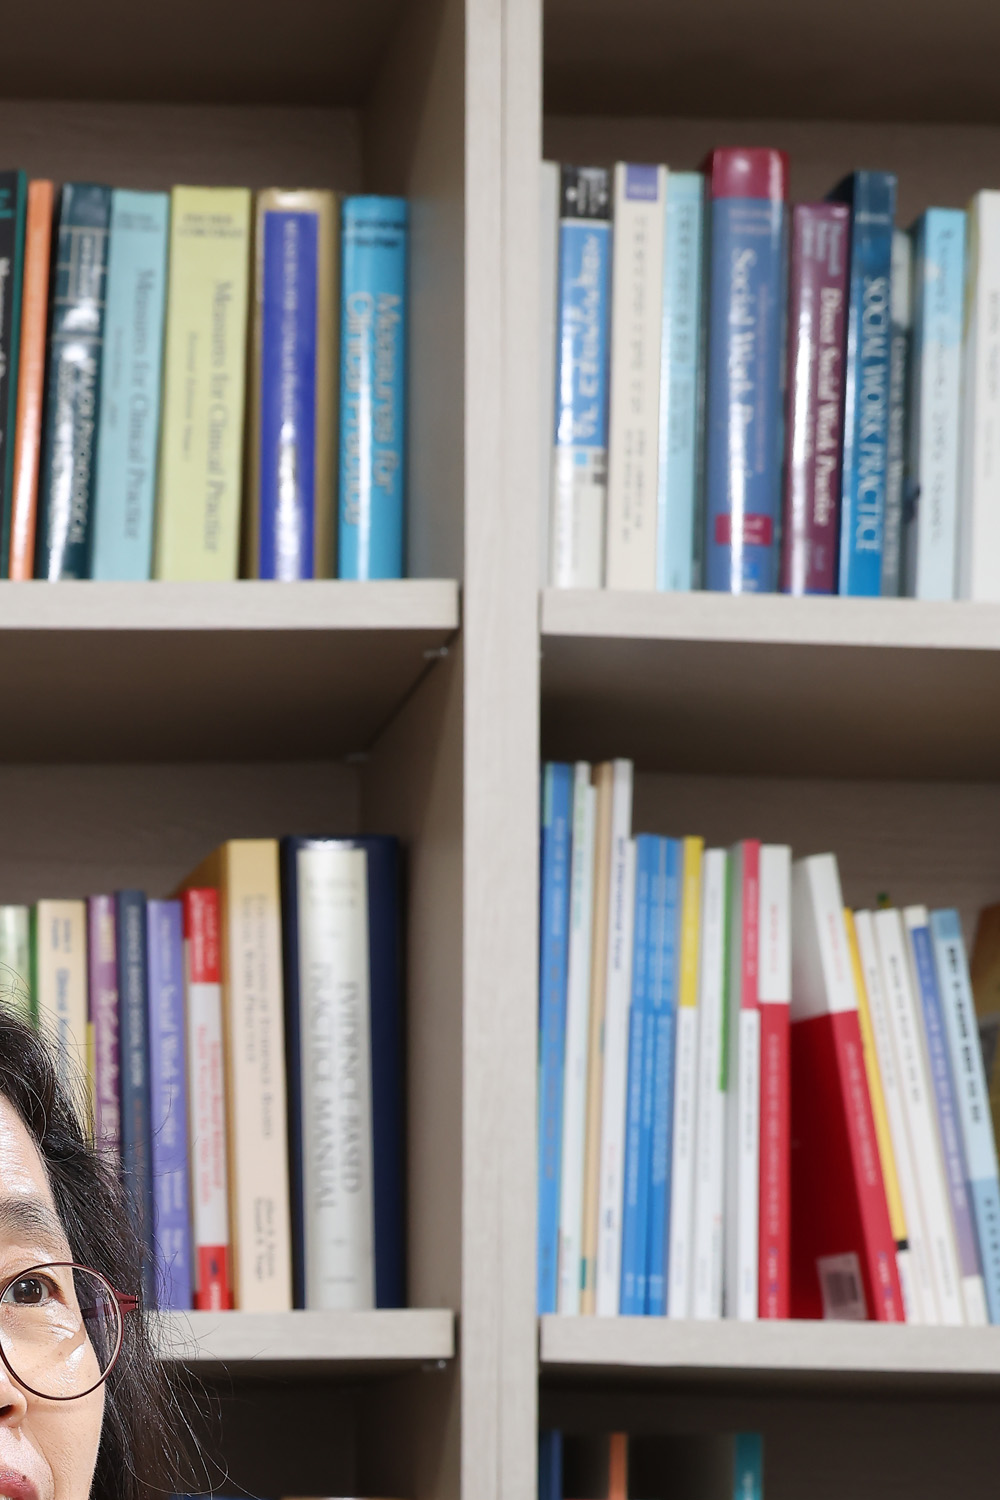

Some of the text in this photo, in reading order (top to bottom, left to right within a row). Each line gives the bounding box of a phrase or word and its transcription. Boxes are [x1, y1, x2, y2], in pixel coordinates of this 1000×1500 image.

[212, 280, 233, 368] Measures
[728, 247, 758, 327] Social
[819, 286, 842, 344] Direct
[345, 290, 374, 393] Clinical
[728, 331, 757, 399] Work
[815, 345, 841, 401] Social
[122, 267, 154, 541] Measures for Clinical Practice
[210, 372, 232, 399] for
[371, 291, 402, 495] Measures for
[854, 275, 889, 554] SOCIAL WORK PRACTICE
[205, 403, 229, 475] Clinical
[814, 402, 838, 453] Work
[812, 454, 836, 528] Practice
[157, 984, 177, 1032] Social
[159, 1034, 179, 1091] Work
[309, 960, 338, 1212] PRACTICE MANUAL
[335, 980, 363, 1194] EVIDENCE-BASED
